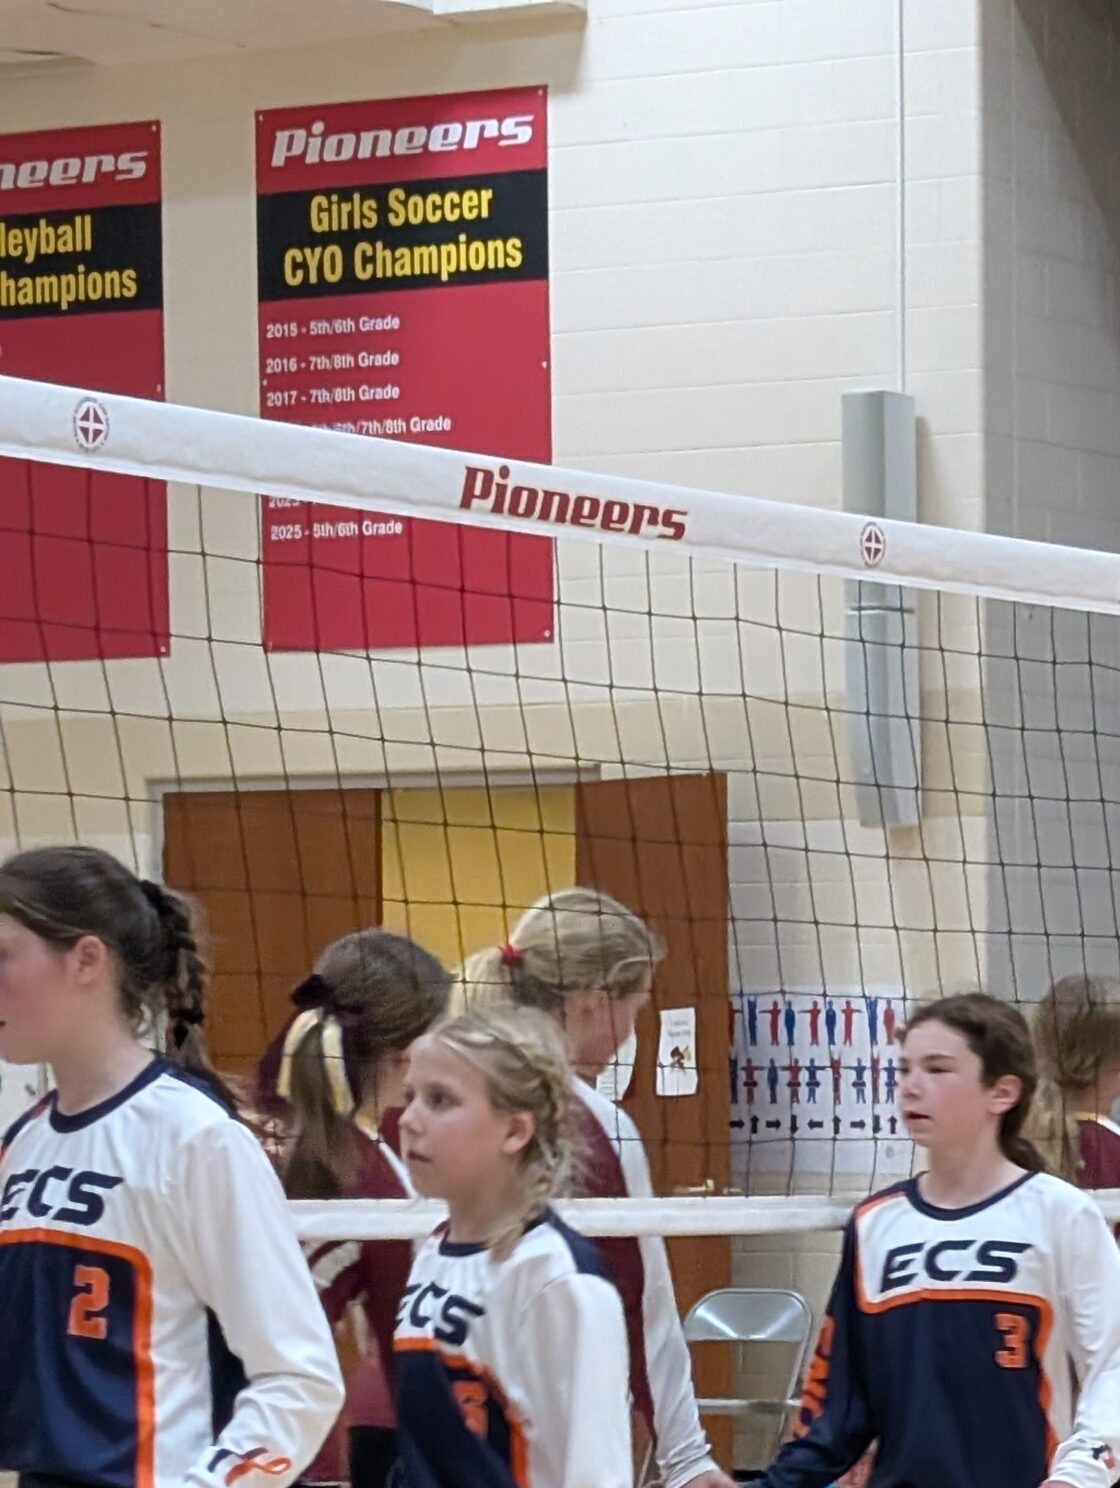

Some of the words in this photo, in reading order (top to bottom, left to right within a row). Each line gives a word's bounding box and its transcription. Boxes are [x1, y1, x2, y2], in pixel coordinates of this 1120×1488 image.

[271, 115, 534, 168] Pioneers
[310, 193, 378, 233] Girls
[388, 188, 493, 227] Soccer
[0, 214, 92, 264] leyball
[284, 244, 343, 287] CYO
[354, 233, 523, 281] Champions
[0, 264, 138, 310] hampions
[266, 322, 298, 338] 2015
[309, 317, 355, 335] 5th/6th
[359, 314, 400, 332] Grade
[266, 357, 297, 374] 2016
[309, 354, 354, 370] 7th/8th
[358, 350, 399, 367] Grade
[266, 390, 297, 407] 2017
[310, 388, 355, 404] 7th/8th
[359, 384, 400, 400] Grade
[410, 416, 451, 432] Grade
[459, 465, 689, 541] Pioneers
[271, 524, 302, 540] 2025
[313, 521, 359, 538] 5th/6th
[362, 519, 403, 536] Grade
[880, 1239, 1033, 1293] ECS
[67, 1264, 110, 1339] 2
[994, 1313, 1028, 1369] 3
